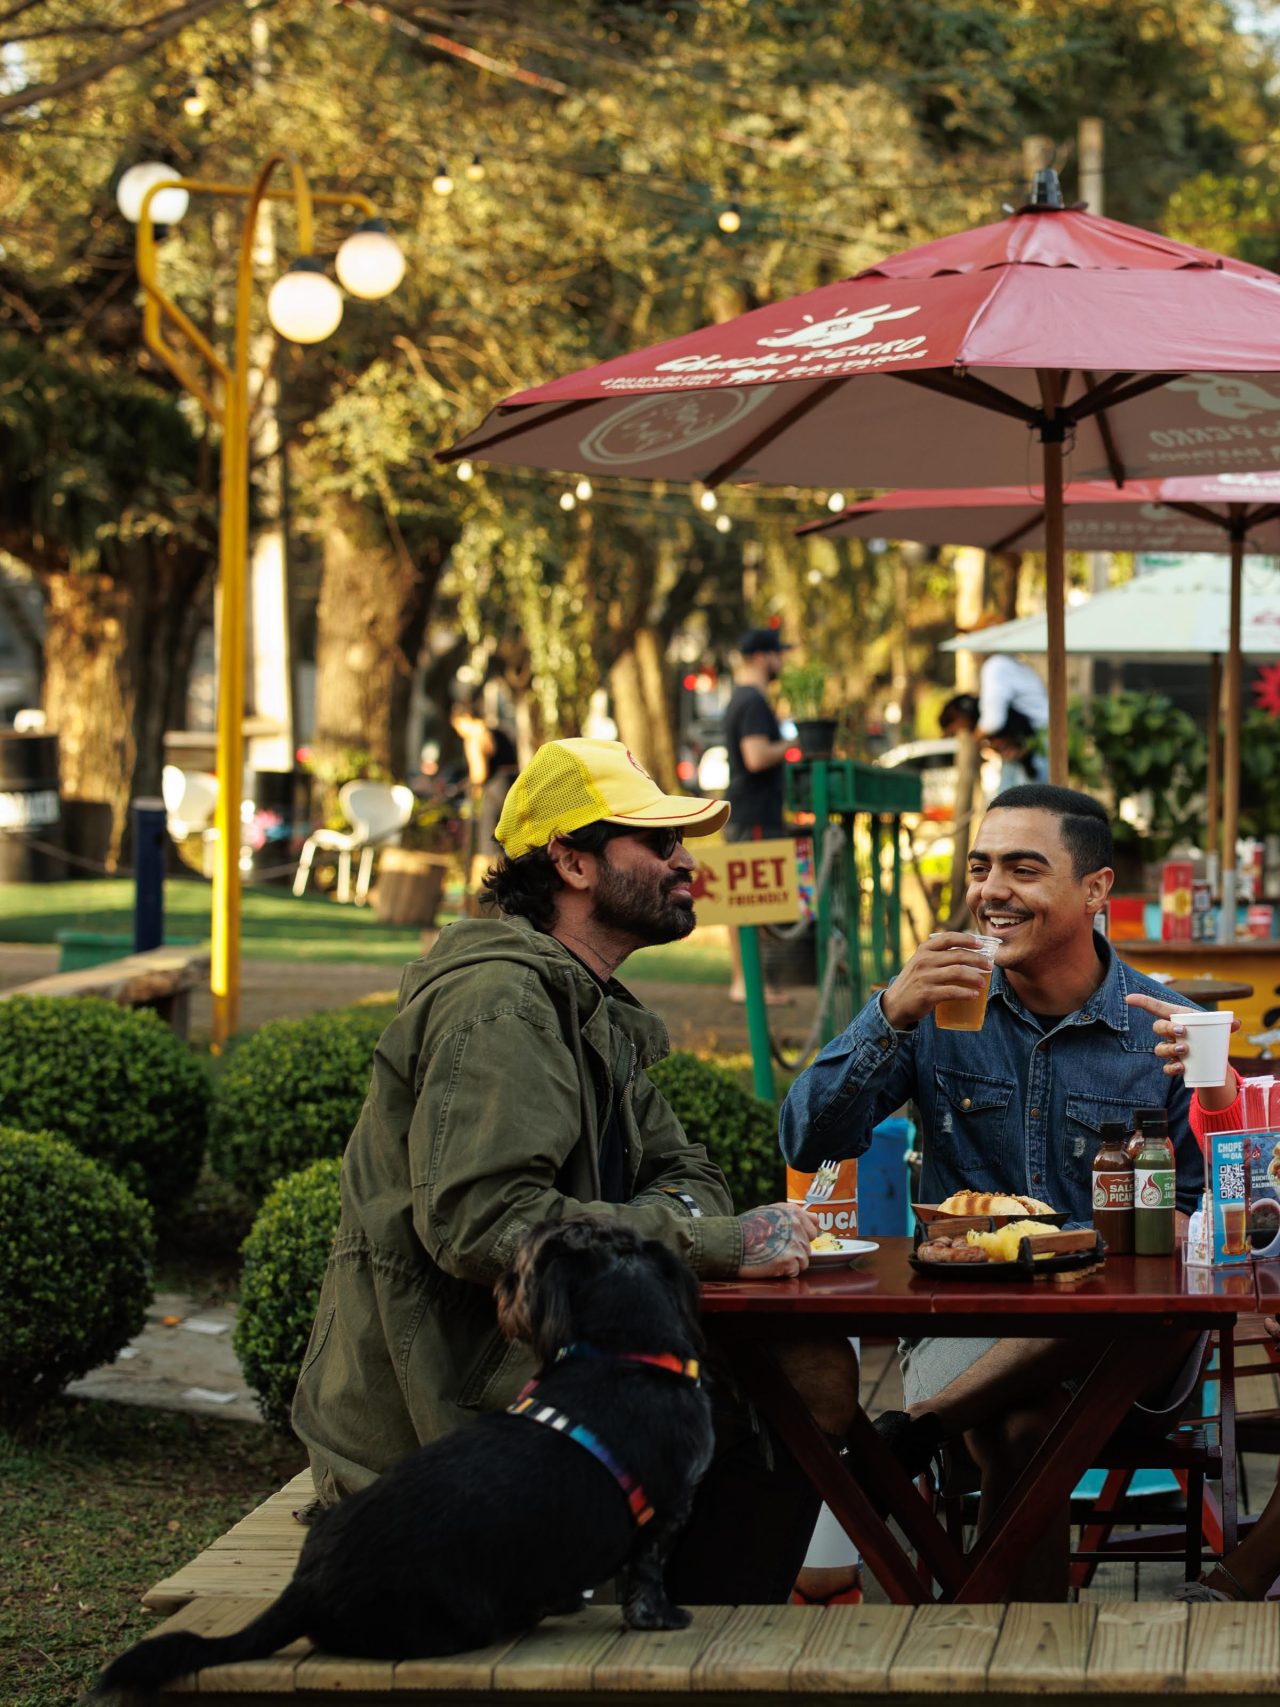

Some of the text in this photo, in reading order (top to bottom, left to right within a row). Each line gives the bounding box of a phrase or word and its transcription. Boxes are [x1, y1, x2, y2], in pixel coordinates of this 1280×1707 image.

[800, 335, 927, 362] PERRO
[727, 857, 786, 891] PET
[728, 892, 789, 906] FRIENDLY
[1218, 1142, 1243, 1153] CHOPE
